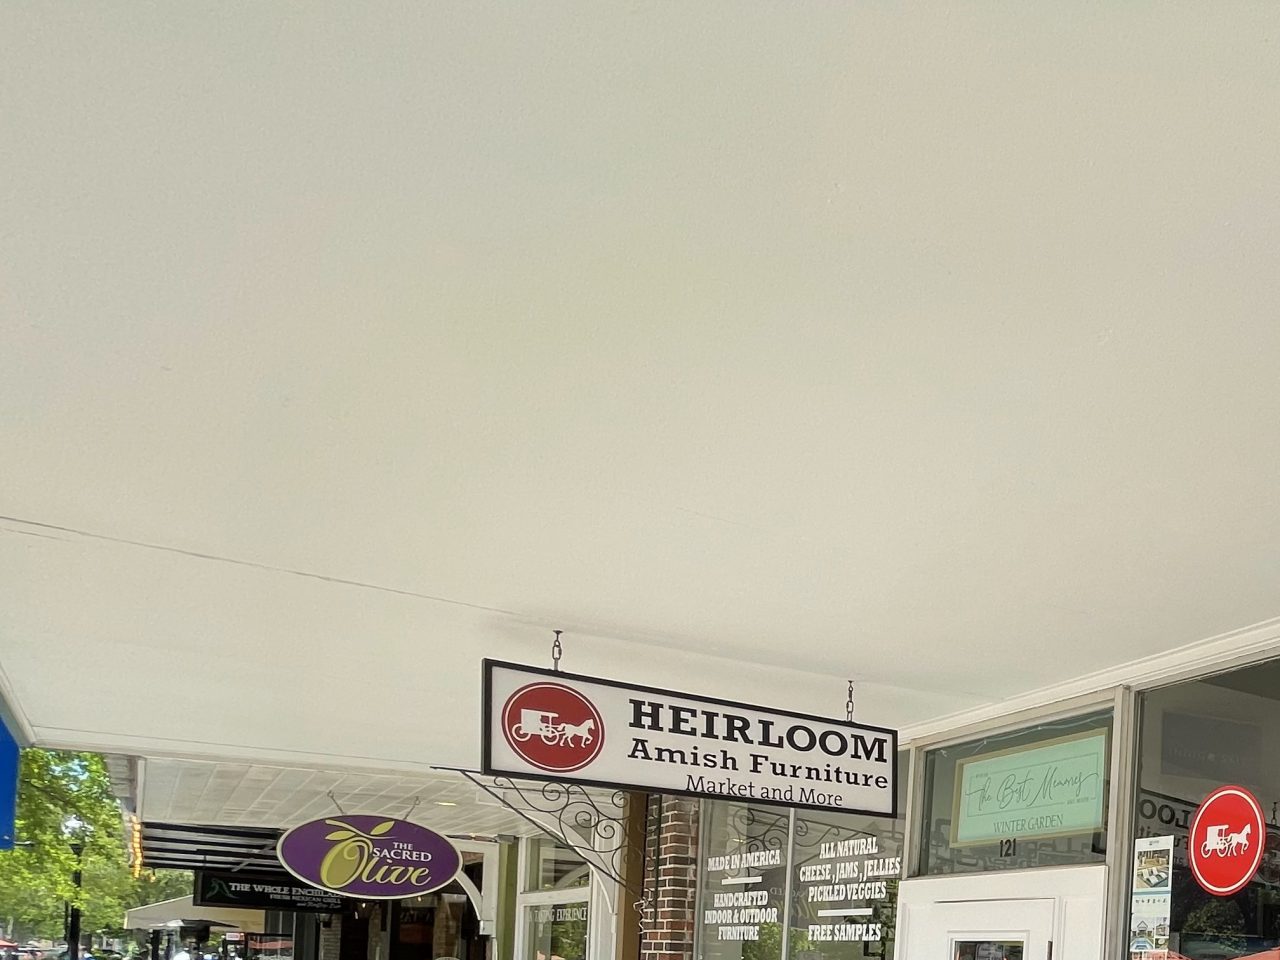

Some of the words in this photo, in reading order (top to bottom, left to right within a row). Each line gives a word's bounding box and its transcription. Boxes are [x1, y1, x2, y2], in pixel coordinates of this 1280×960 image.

[628, 699, 889, 763] HEIRLOOM
[627, 737, 740, 772] Amish
[749, 753, 889, 790] Furniture
[685, 774, 755, 799] Market
[760, 781, 794, 803] and
[799, 788, 844, 807] More
[993, 818, 1026, 834] WINTER
[1028, 814, 1064, 831] GARDEN
[372, 848, 432, 862] SACRED
[392, 842, 413, 850] THE
[819, 843, 836, 859] ALL
[837, 837, 879, 857] NATURAL
[1000, 838, 1017, 858] 121
[320, 836, 432, 888] Olive
[707, 855, 730, 872] MADE
[731, 855, 740, 870] IN
[740, 849, 781, 868] AMERICA
[863, 857, 901, 882] JELLIES
[229, 882, 251, 892] THE
[254, 885, 290, 895] WHOLE
[808, 886, 847, 903] PICKLED
[847, 882, 887, 900] VEGGIES
[714, 890, 769, 908] HANDCRAFTED
[557, 907, 588, 921] EXPERIENCE
[704, 909, 732, 924] INDOOR
[739, 907, 778, 924] OUTDOOR
[718, 925, 760, 941] FURNITURE
[808, 925, 834, 941] FREE
[834, 923, 882, 941] SAMPLES
